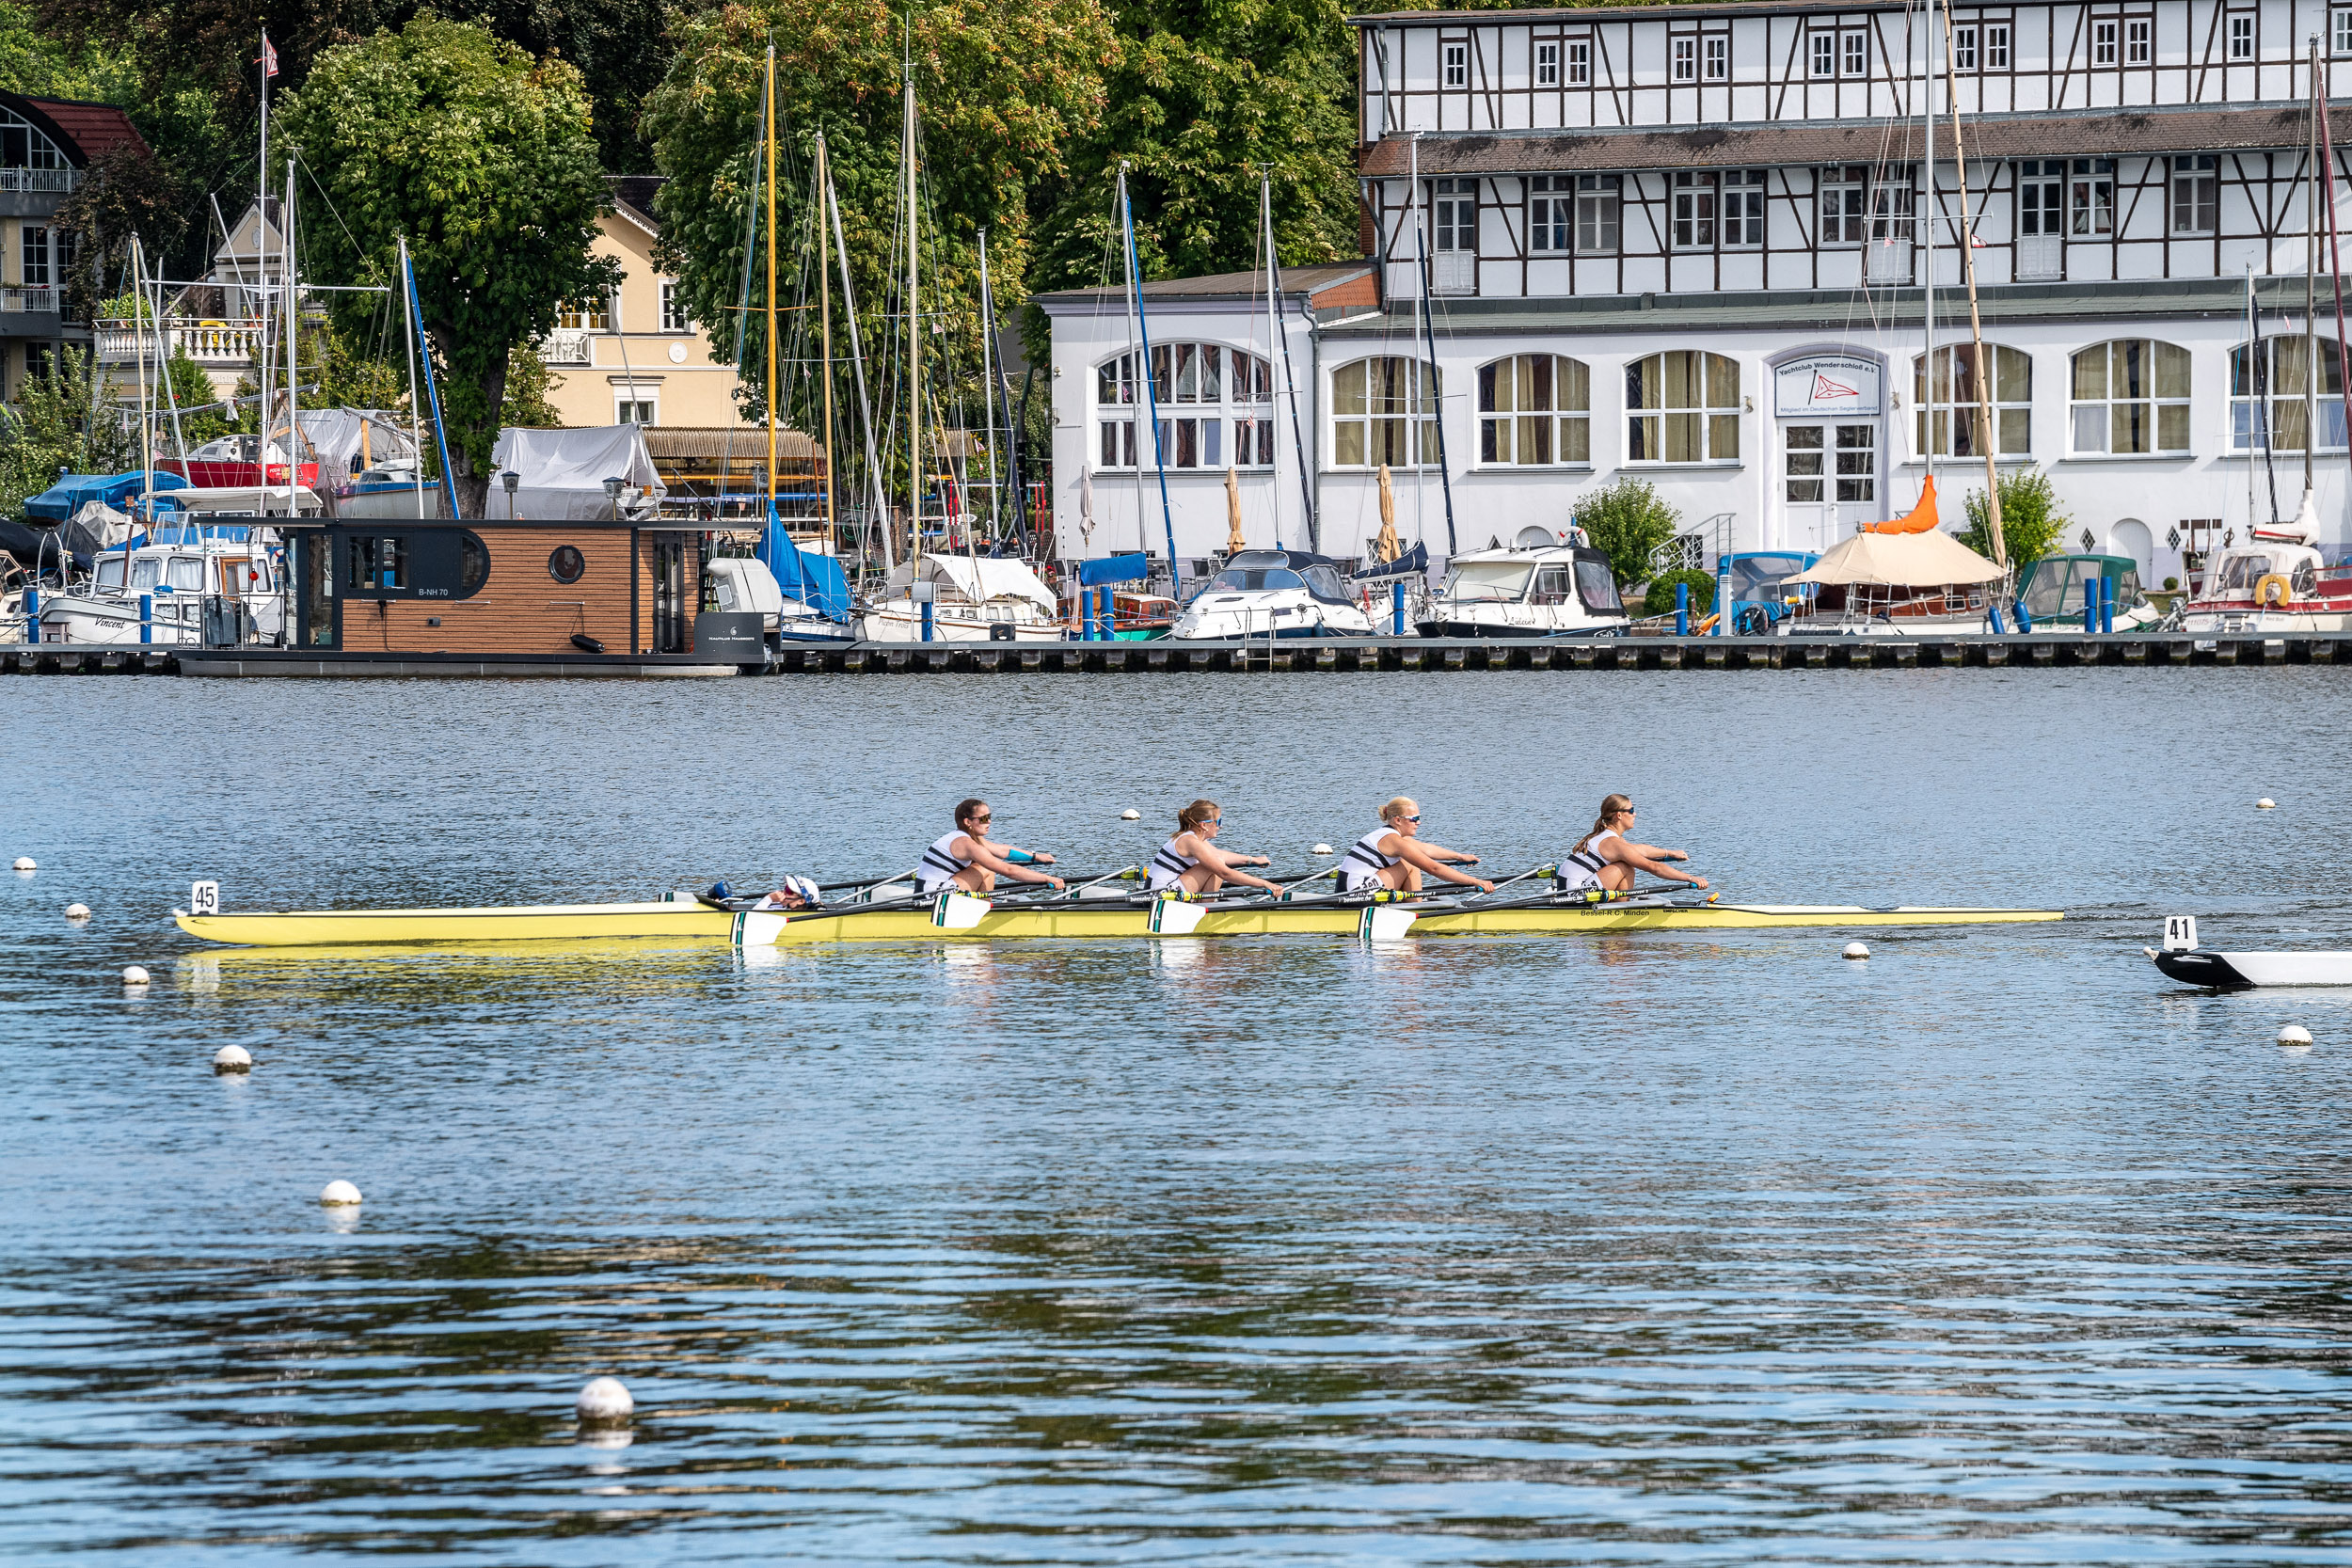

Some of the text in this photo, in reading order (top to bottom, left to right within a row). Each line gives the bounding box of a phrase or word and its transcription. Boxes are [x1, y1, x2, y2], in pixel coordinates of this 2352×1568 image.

[1779, 363, 1813, 376] Yachtclub
[95, 616, 126, 629] Vincent
[195, 886, 215, 908] 45
[2169, 918, 2188, 940] 41
